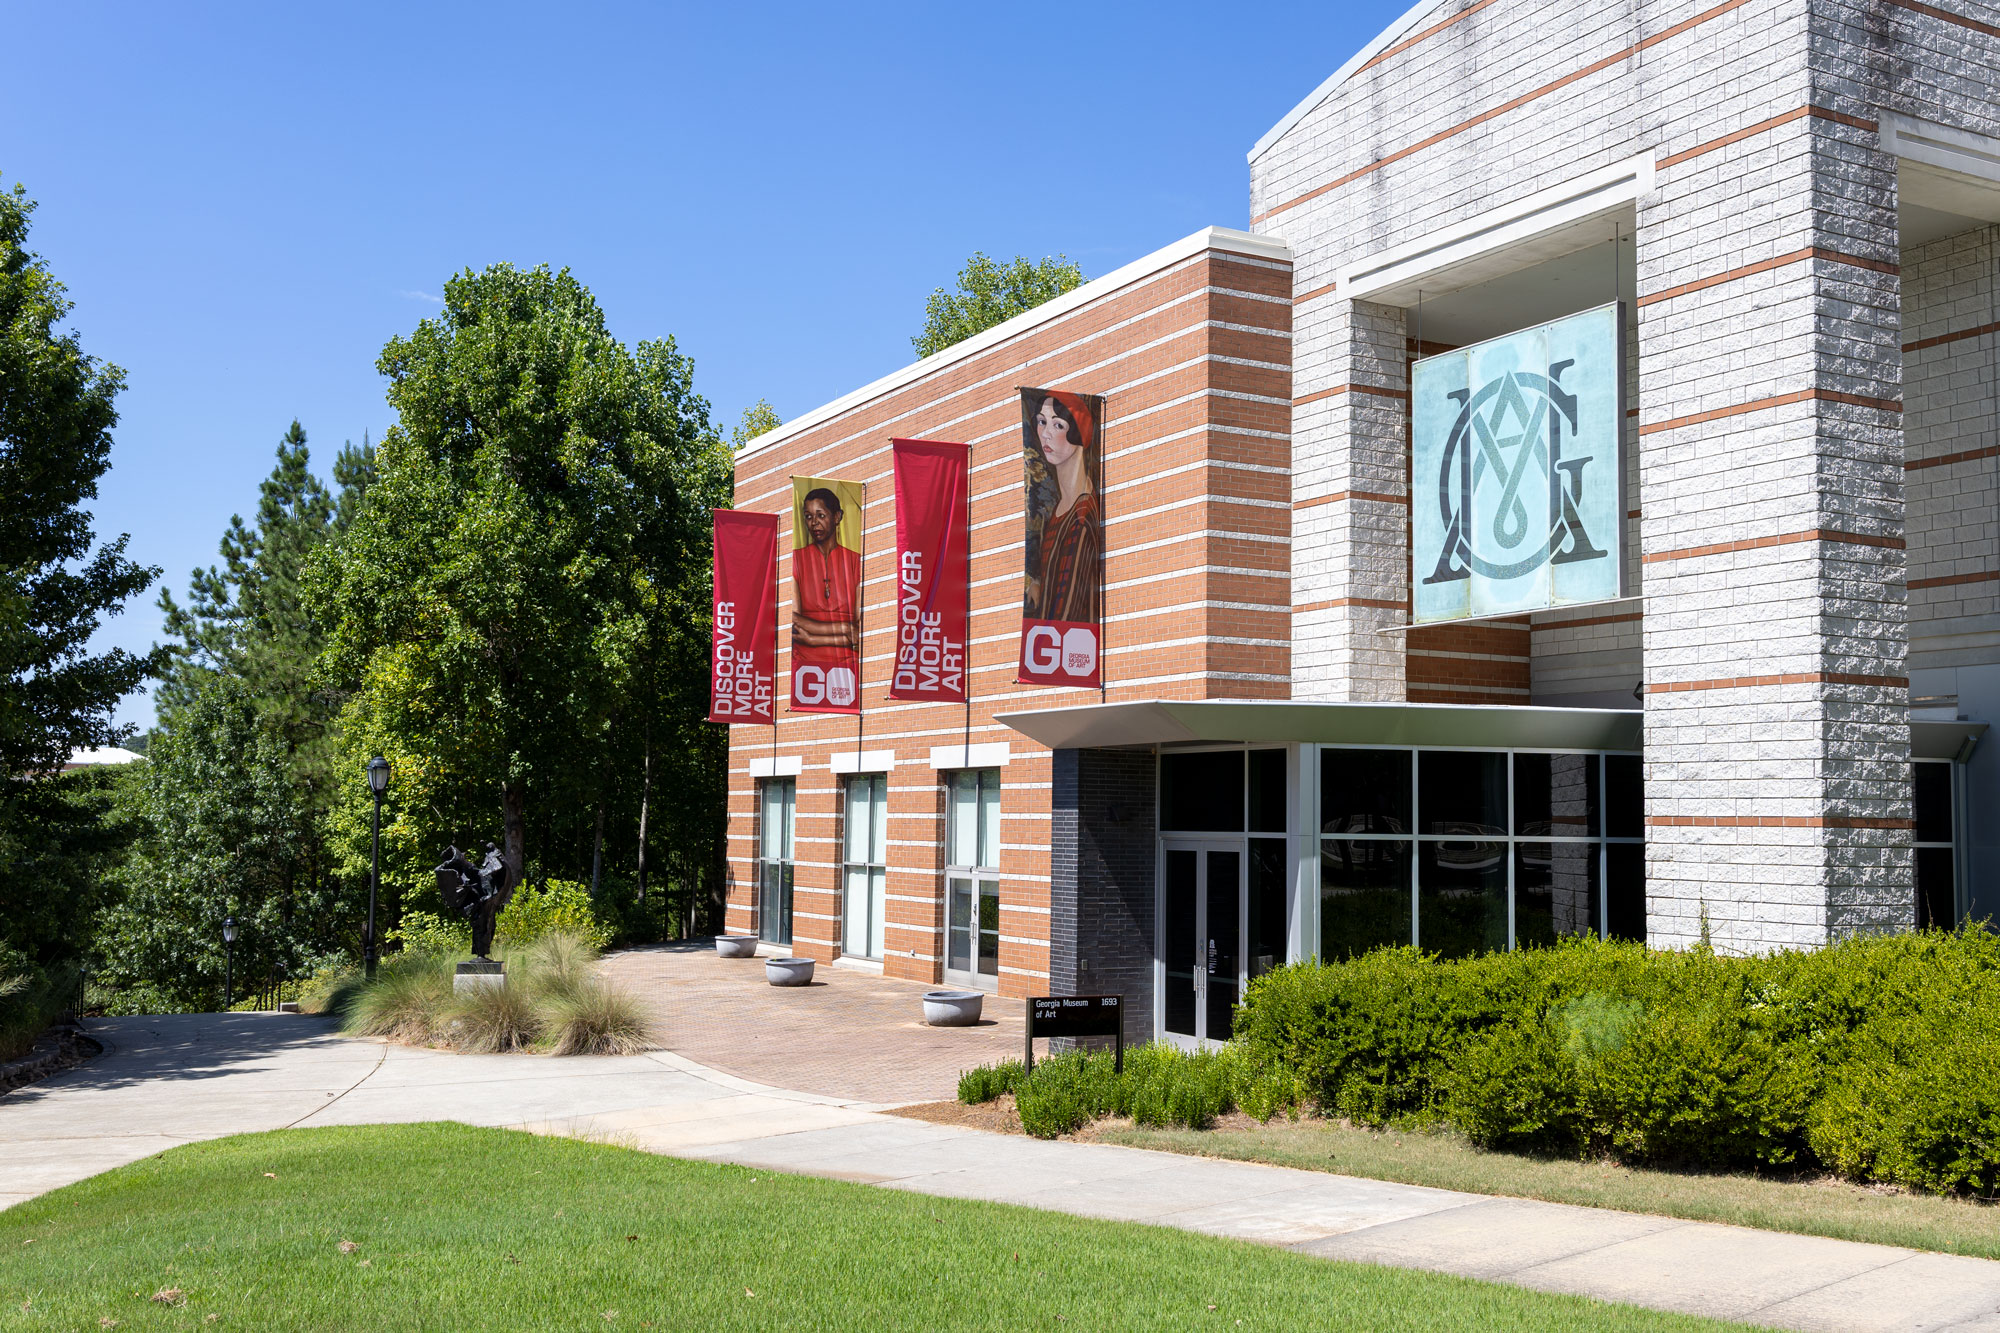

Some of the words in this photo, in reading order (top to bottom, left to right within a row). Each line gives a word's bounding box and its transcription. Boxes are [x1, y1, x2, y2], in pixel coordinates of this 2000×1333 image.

[894, 550, 922, 690] DISCOVER
[714, 601, 735, 715] DISCOVER
[918, 611, 941, 691] MORE
[942, 636, 962, 693] ART
[734, 650, 754, 716] MORE
[753, 671, 772, 717] ART
[1035, 999, 1060, 1009] Georgia
[1062, 999, 1089, 1007] Museum
[1101, 998, 1118, 1006] 1693
[1035, 1010, 1043, 1018] of
[1045, 1010, 1057, 1018] Art
